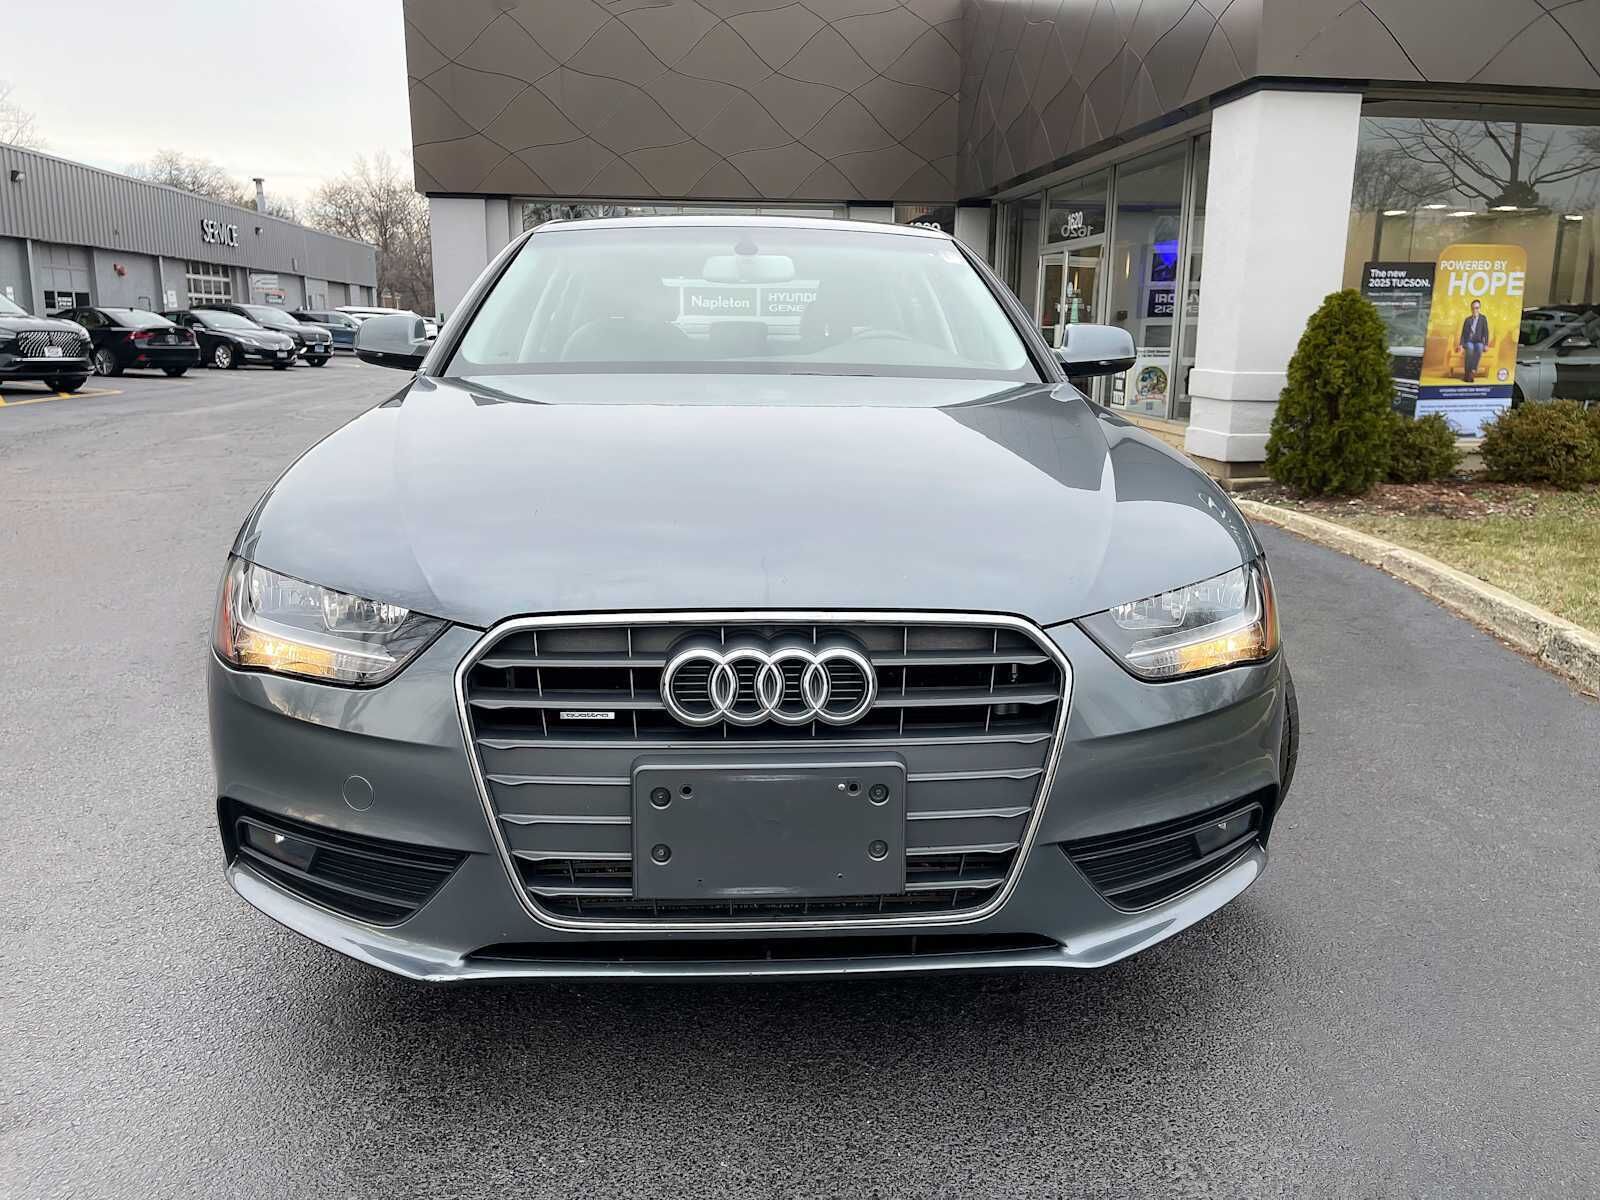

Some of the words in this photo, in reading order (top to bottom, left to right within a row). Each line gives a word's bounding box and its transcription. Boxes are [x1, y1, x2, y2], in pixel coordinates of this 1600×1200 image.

[201, 219, 239, 247] SERVICE
[1440, 260, 1492, 270] POWERED
[1494, 260, 1508, 270] BY
[1370, 269, 1387, 278] The
[1387, 270, 1407, 278] new
[1368, 279, 1391, 288] 2025
[1391, 279, 1431, 288] TUCSON.
[1447, 271, 1526, 297] HOPE
[691, 295, 750, 310] Napleton
